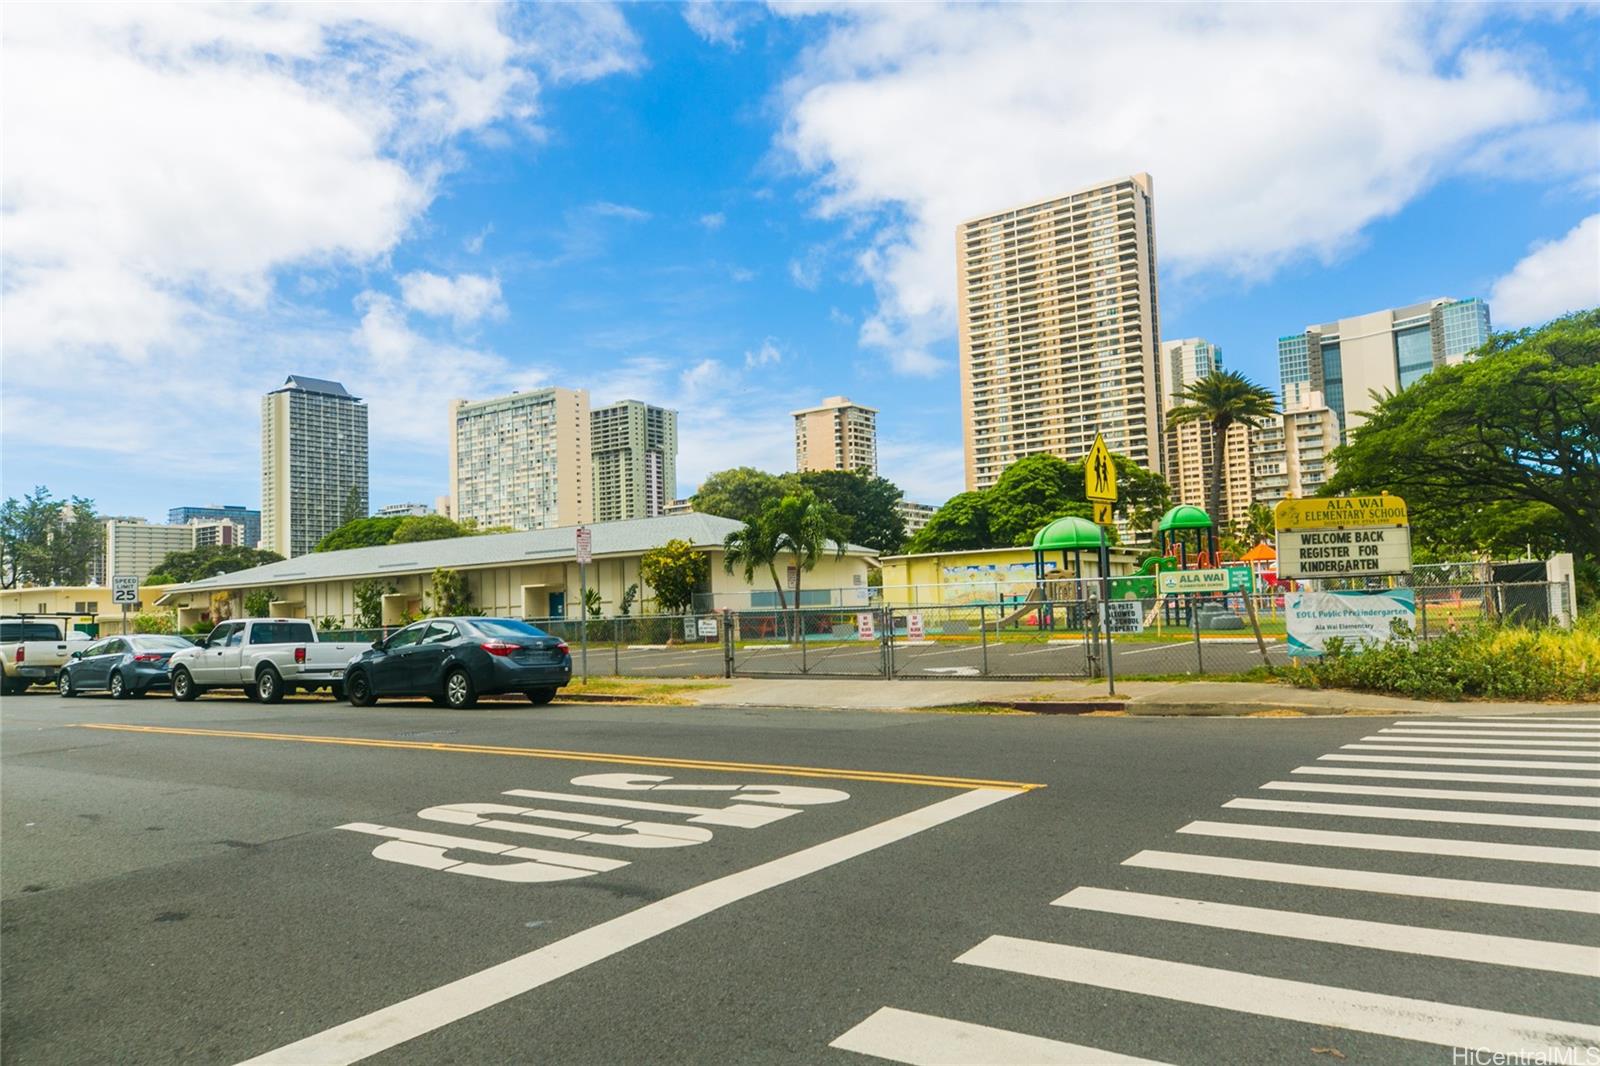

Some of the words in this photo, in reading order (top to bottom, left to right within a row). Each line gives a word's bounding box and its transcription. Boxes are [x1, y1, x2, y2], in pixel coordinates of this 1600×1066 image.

[1326, 499, 1353, 510] ALA
[1358, 498, 1384, 509] WAI
[1305, 508, 1365, 522] ELEMENTARY
[1369, 507, 1406, 519] SCHOOL
[1301, 533, 1352, 545] WELCOME
[1355, 531, 1384, 543] BACK
[1299, 546, 1350, 559] REGISTER
[1358, 545, 1379, 556] FOR
[1300, 559, 1379, 573] KINDERGARTEN
[1179, 574, 1201, 583] ALA
[1203, 573, 1224, 582] WAI
[115, 590, 136, 601] 25
[1319, 610, 1341, 619] Public
[1343, 608, 1408, 619] Prekindergarten
[1115, 617, 1139, 625] SCHOOL
[1326, 623, 1338, 631] Wai
[1339, 623, 1374, 631] Elementary
[334, 773, 850, 883] STOP
